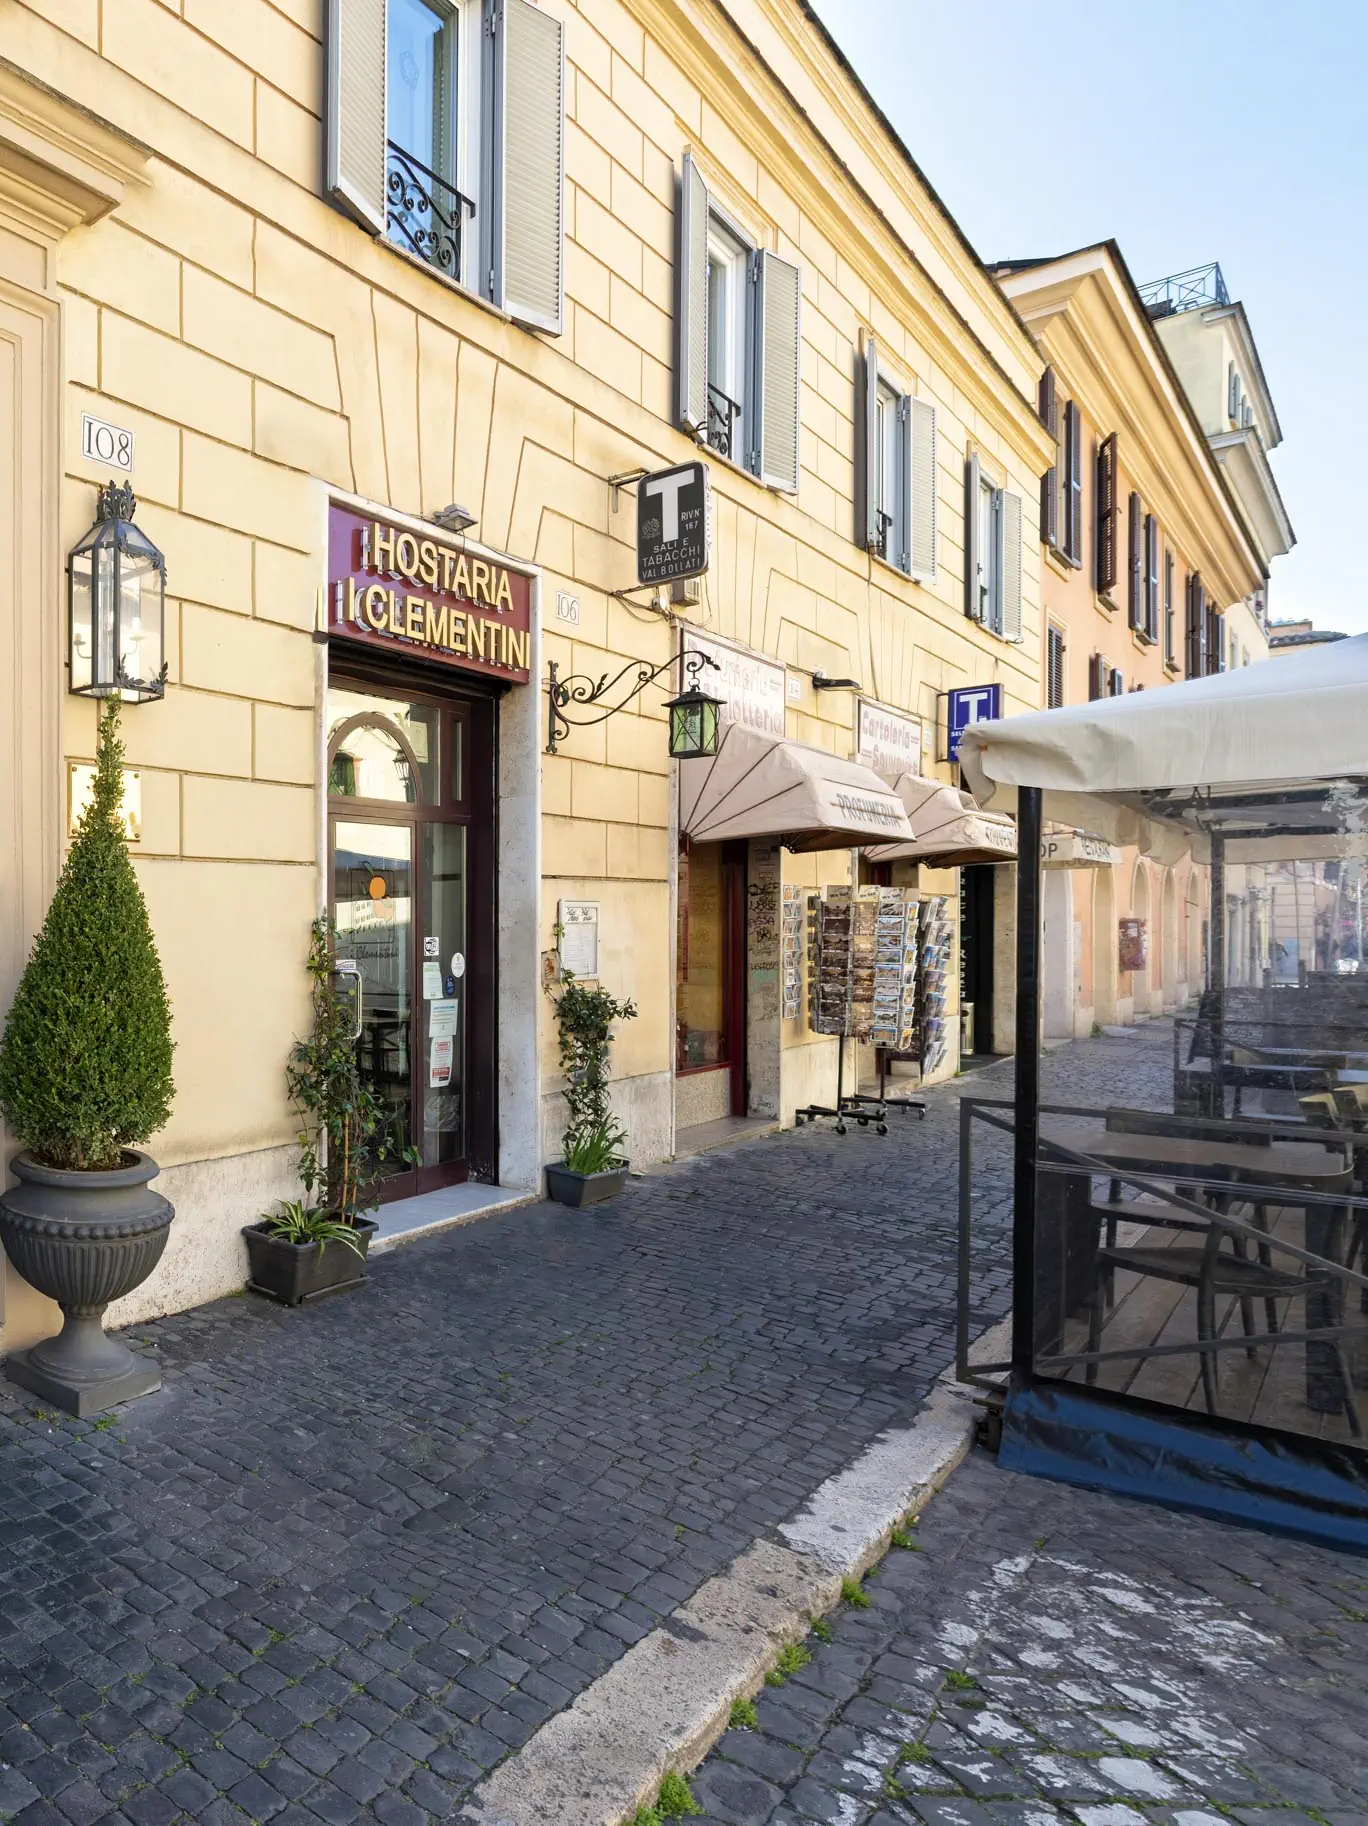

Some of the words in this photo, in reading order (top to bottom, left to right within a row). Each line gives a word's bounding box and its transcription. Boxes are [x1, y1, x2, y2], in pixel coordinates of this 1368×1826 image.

[86, 420, 130, 466] 108
[646, 468, 695, 543] T
[642, 544, 700, 568] TABACCHI
[653, 540, 677, 554] SALI
[682, 537, 689, 546] E
[372, 522, 515, 612] HOSTARIA
[661, 557, 700, 576] BOLLATI
[557, 593, 578, 622] 106
[365, 584, 531, 670] CLEMENTINI
[959, 692, 988, 725] T
[863, 710, 910, 750] Cartoleria
